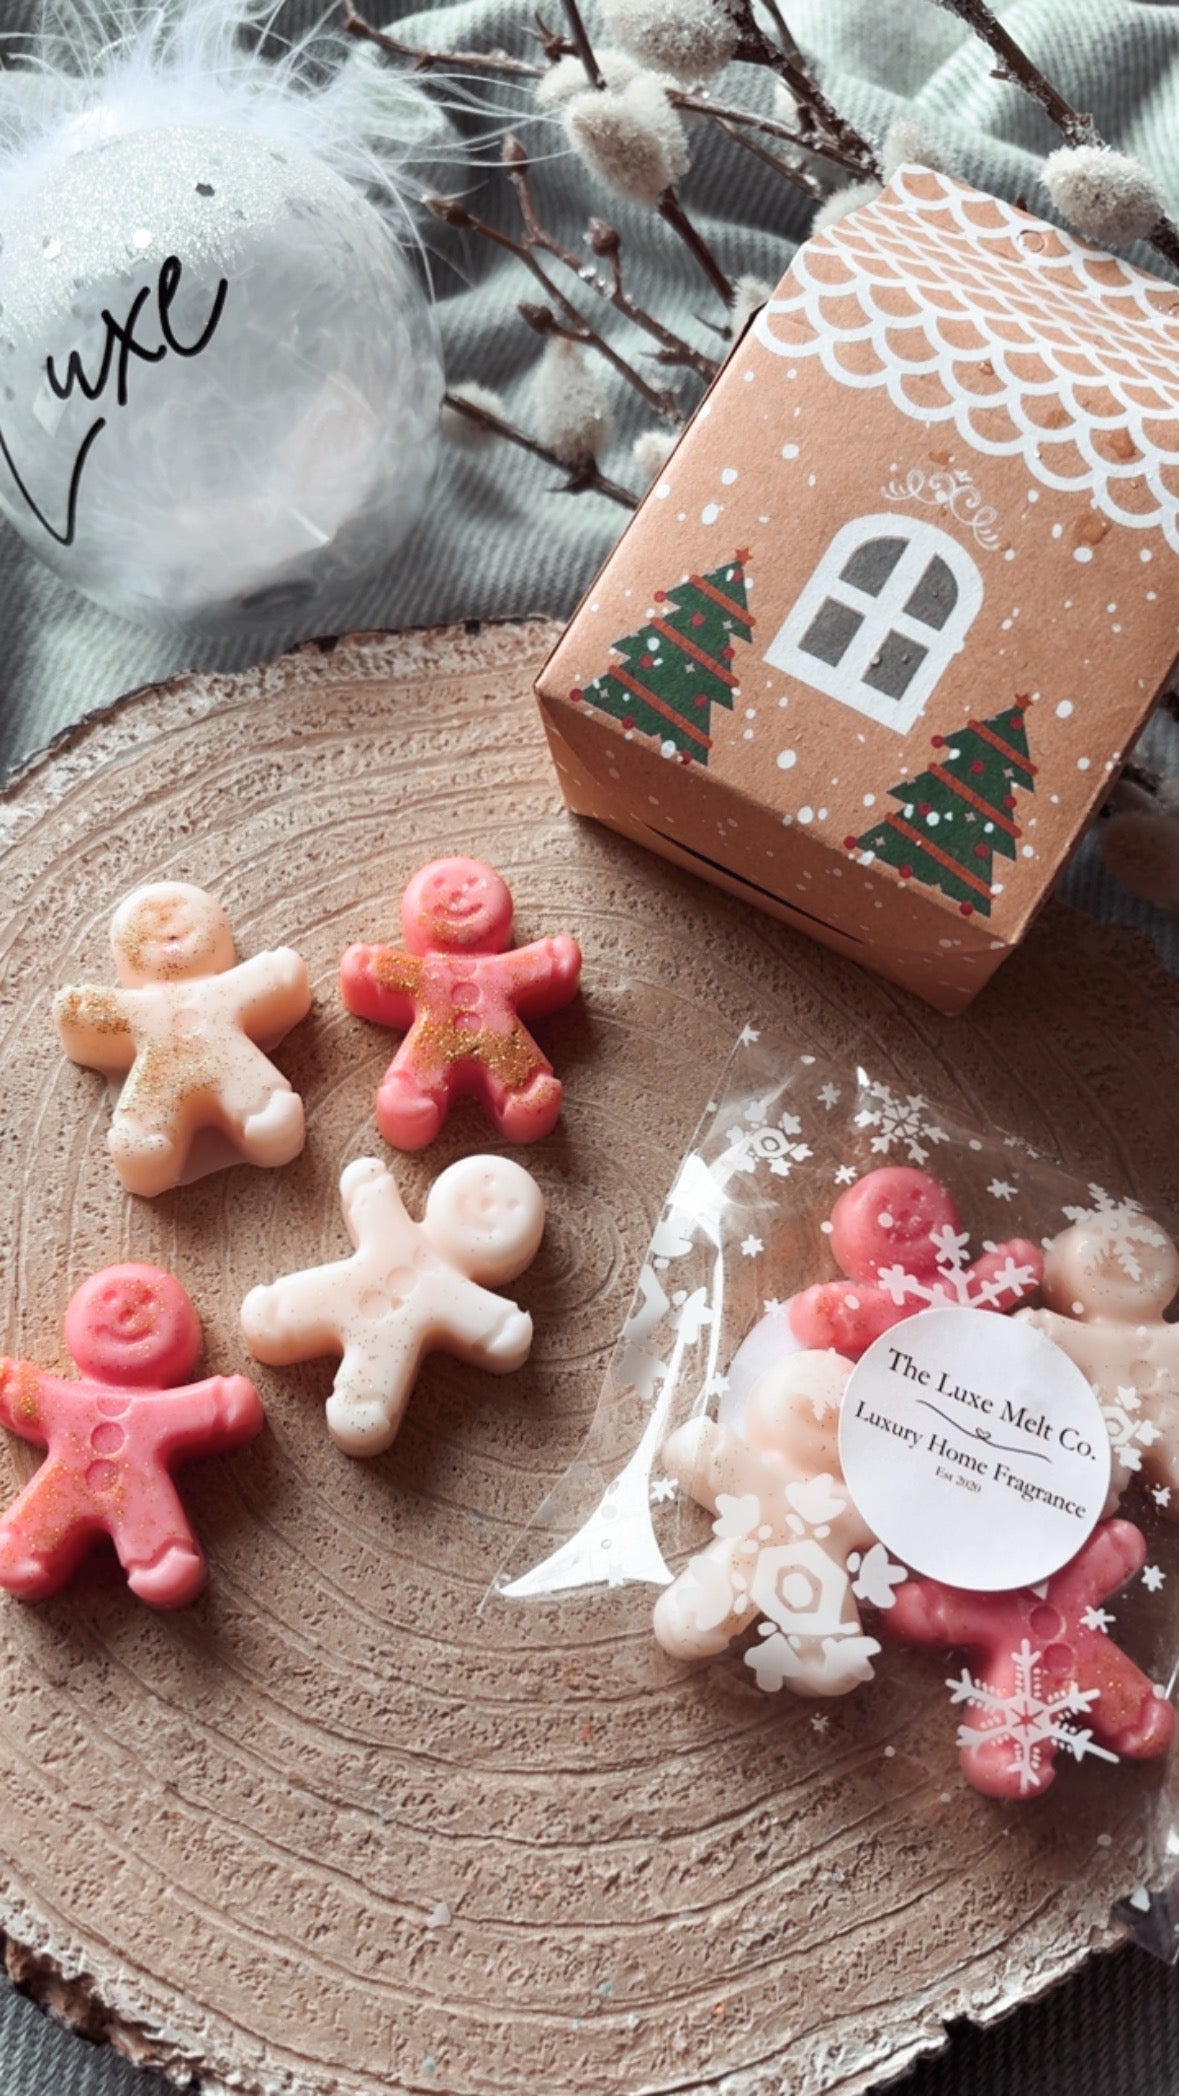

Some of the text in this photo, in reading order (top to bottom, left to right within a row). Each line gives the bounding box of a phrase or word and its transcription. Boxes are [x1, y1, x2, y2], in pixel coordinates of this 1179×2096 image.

[855, 1401, 1086, 1519] Luxury Home Fragrance
[888, 1347, 1097, 1460] The Luxe Melt Co.
[935, 1466, 982, 1494] Est 2020
